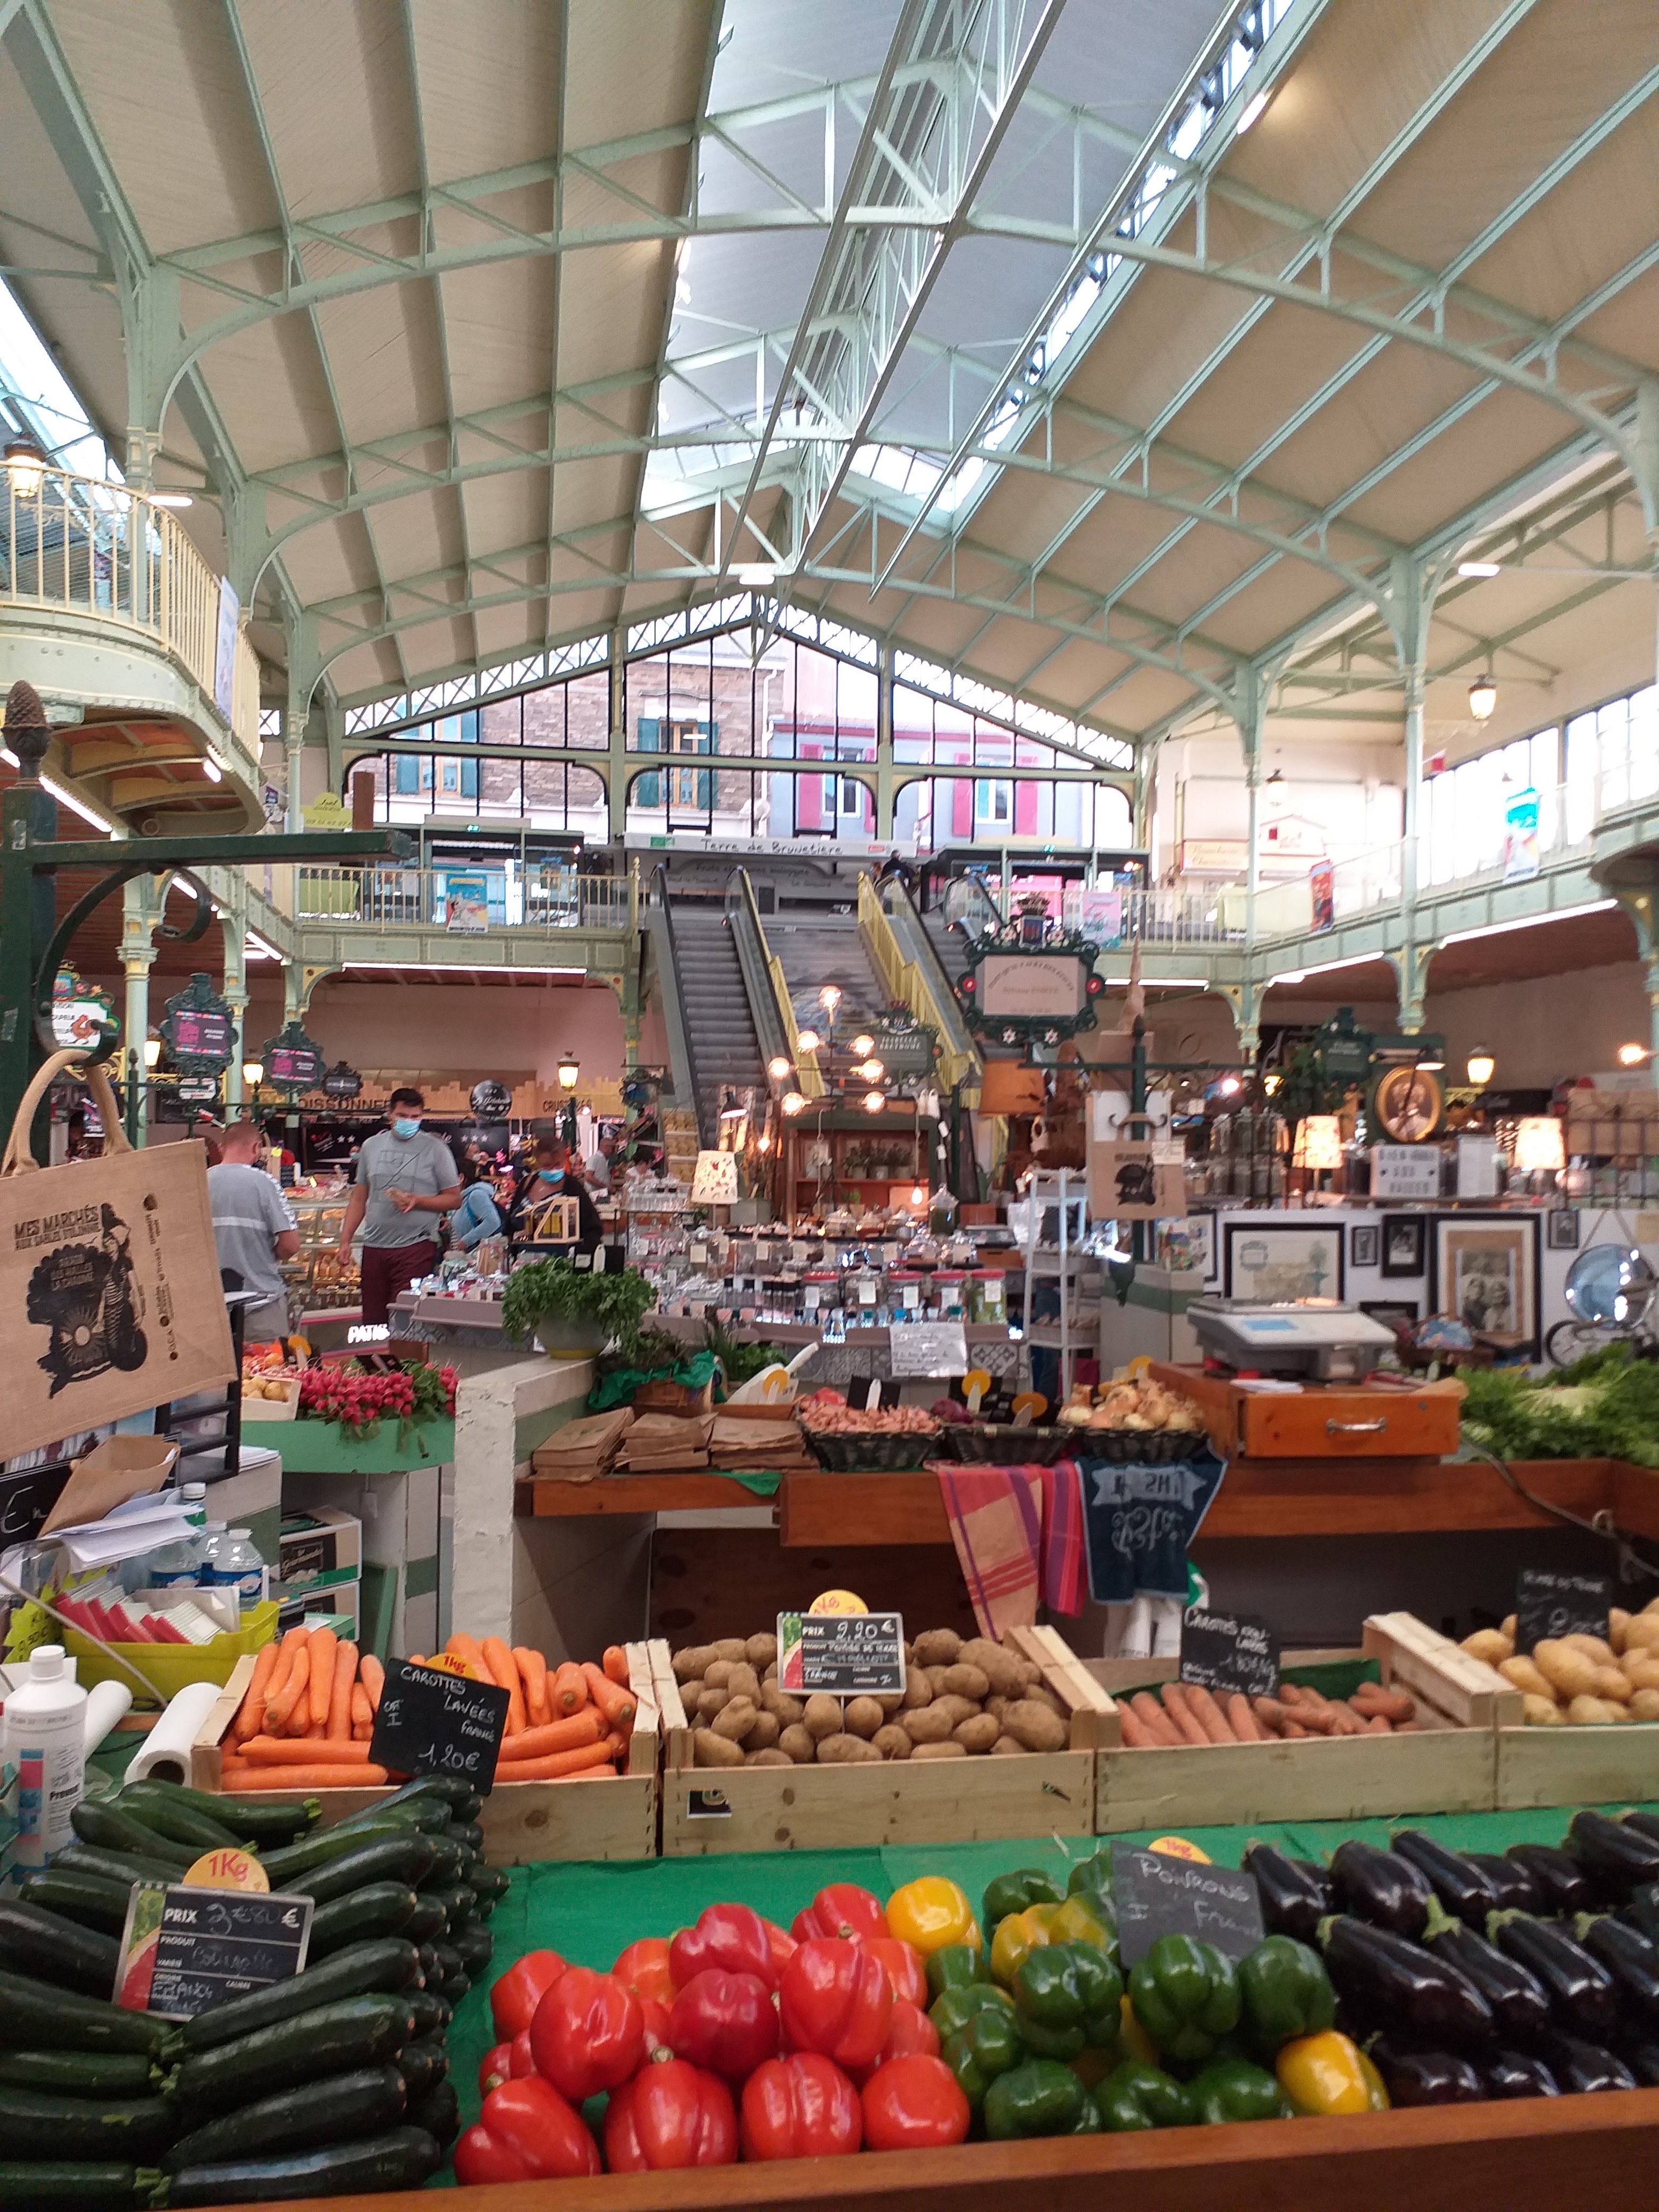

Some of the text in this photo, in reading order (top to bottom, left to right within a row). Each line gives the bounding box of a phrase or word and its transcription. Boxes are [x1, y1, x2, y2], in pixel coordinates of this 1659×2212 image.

[700, 838, 739, 852] Terre
[748, 840, 764, 853] de
[14, 1217, 41, 1240] MES
[802, 1626, 825, 1637] PRIX
[400, 1666, 466, 1695] CAROTTES
[444, 1694, 496, 1724] LAVÉES
[417, 1743, 481, 1772] 1,20€
[208, 1852, 249, 1884] 1Kg
[162, 1908, 199, 1924] PRIX
[160, 1935, 197, 1947] PRODUIT
